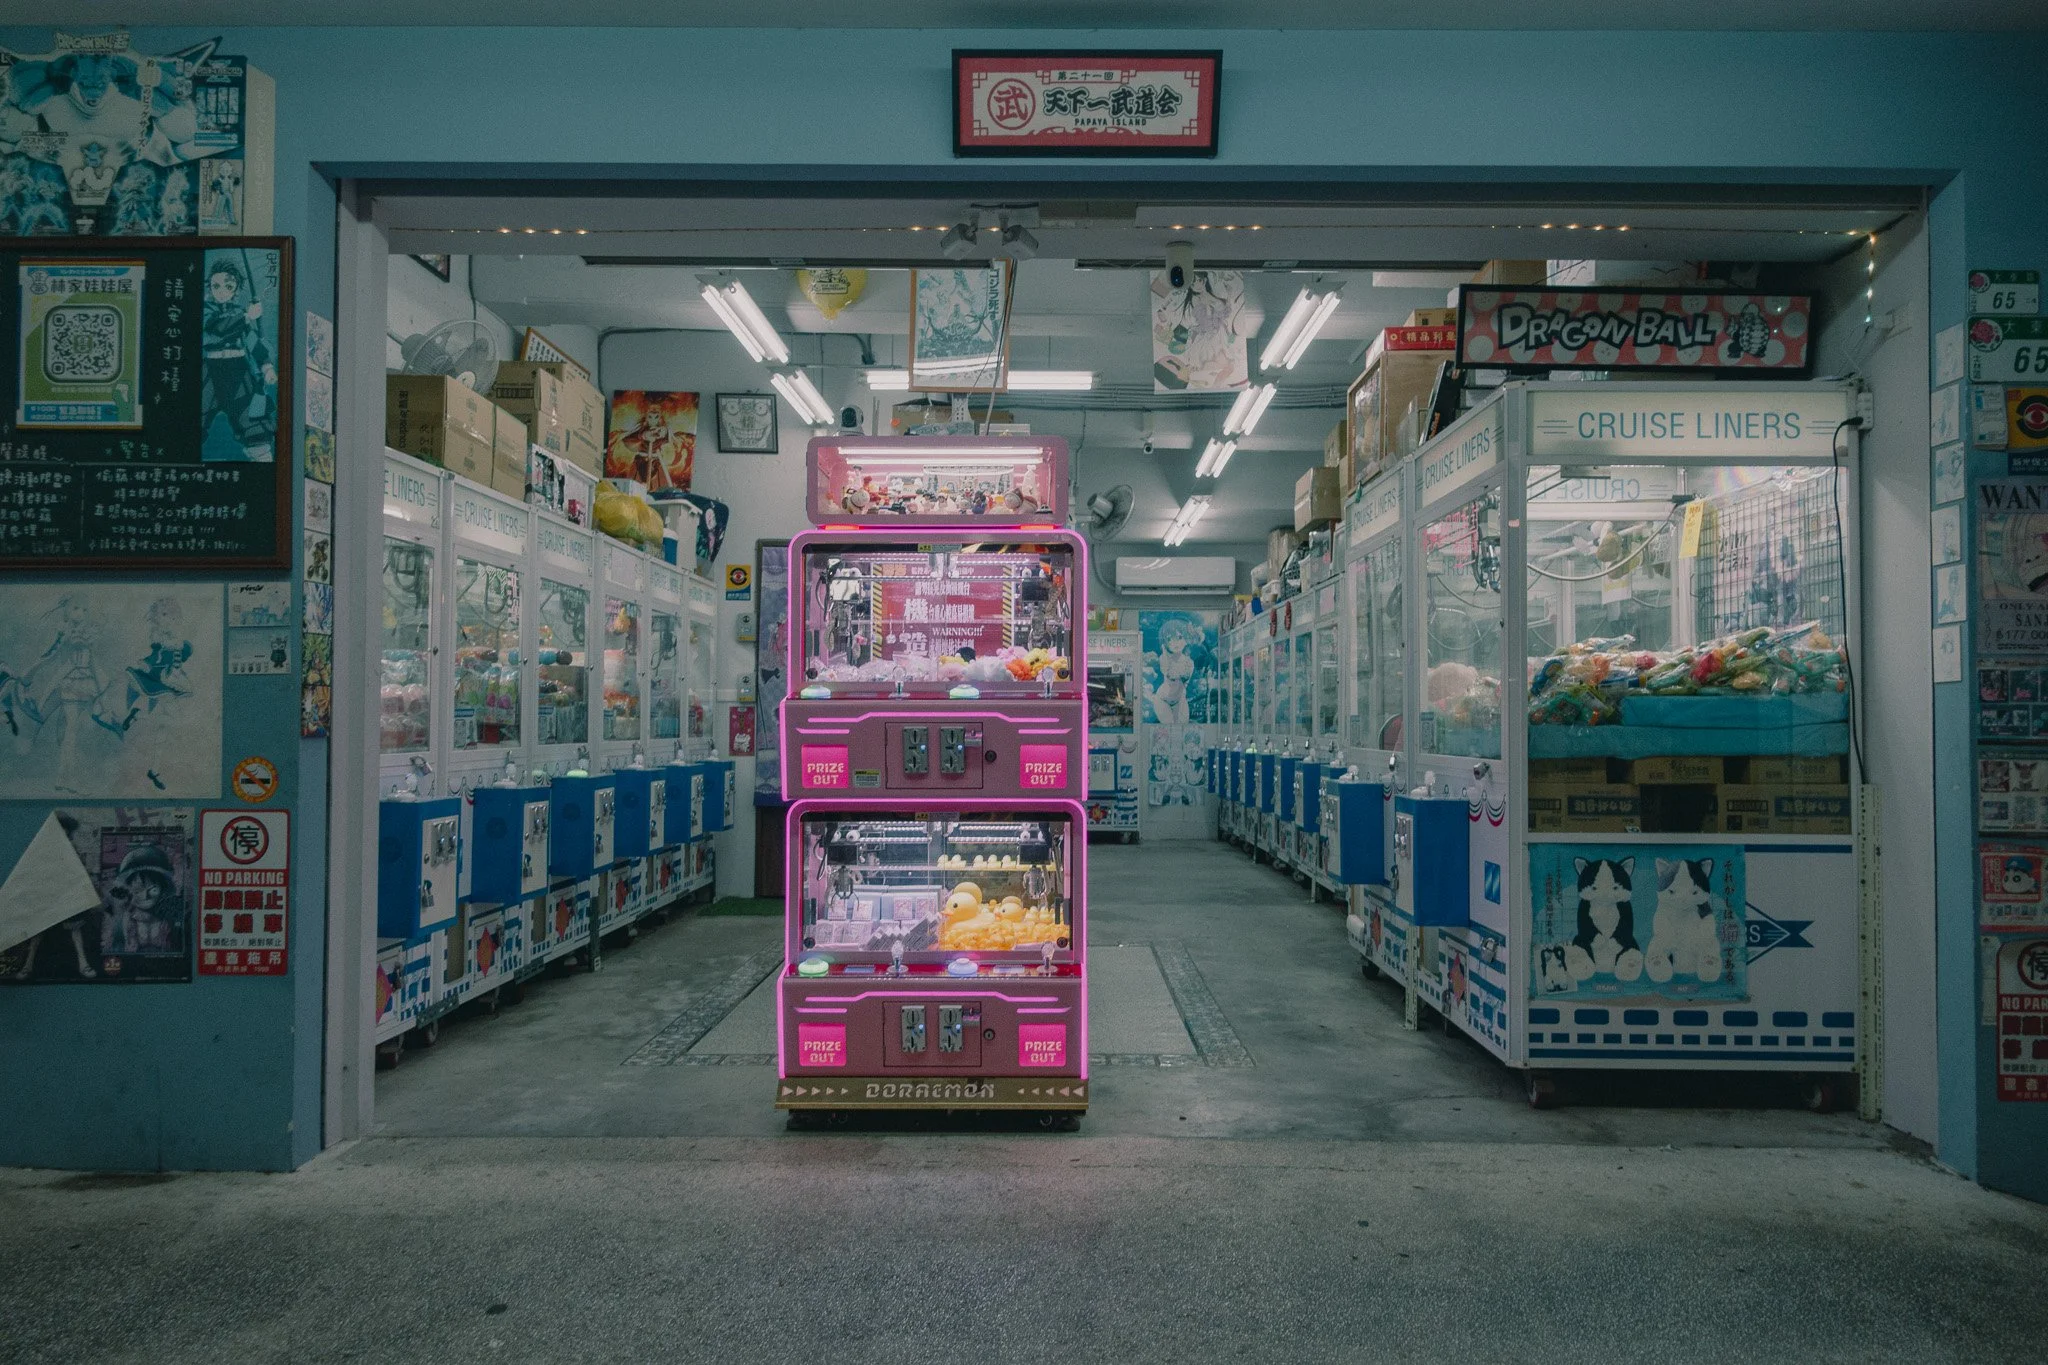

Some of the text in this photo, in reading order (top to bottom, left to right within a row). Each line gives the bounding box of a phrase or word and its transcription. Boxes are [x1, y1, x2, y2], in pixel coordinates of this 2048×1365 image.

[1057, 71, 1114, 81] 第二十一回
[993, 86, 1028, 122] 武
[1044, 87, 1181, 116] 天下一武道会
[1074, 118, 1147, 126] PAPAYA ISLAND
[1992, 291, 2016, 310] 65
[1500, 303, 1716, 350] DRAGON BALL
[2014, 346, 2048, 374] 65
[1578, 412, 1801, 439] CRUISE LINERS
[1424, 428, 1491, 490] CRUISE LINERS
[392, 471, 426, 507] LINERS
[1980, 484, 2048, 509] WAN
[1353, 488, 1396, 532] CRUISE LINERS
[464, 500, 519, 539] CRUISE LINERS
[544, 529, 565, 555] CRUISE
[932, 625, 985, 637] WARNING!!!
[1099, 638, 1127, 648] LINERS
[807, 762, 844, 774] PRIZE
[1025, 762, 1062, 774] PRIZE
[812, 774, 839, 785] OUT
[1030, 774, 1057, 785] OUT
[230, 825, 260, 855] 停
[204, 872, 285, 885] NO PARKING
[2002, 997, 2020, 1010] NO
[804, 1040, 842, 1052] PRIZE
[1024, 1040, 1062, 1052] PRIZE
[809, 1052, 836, 1064] OUT
[1030, 1052, 1057, 1064] OUT
[866, 1083, 996, 1099] DORAEMON
